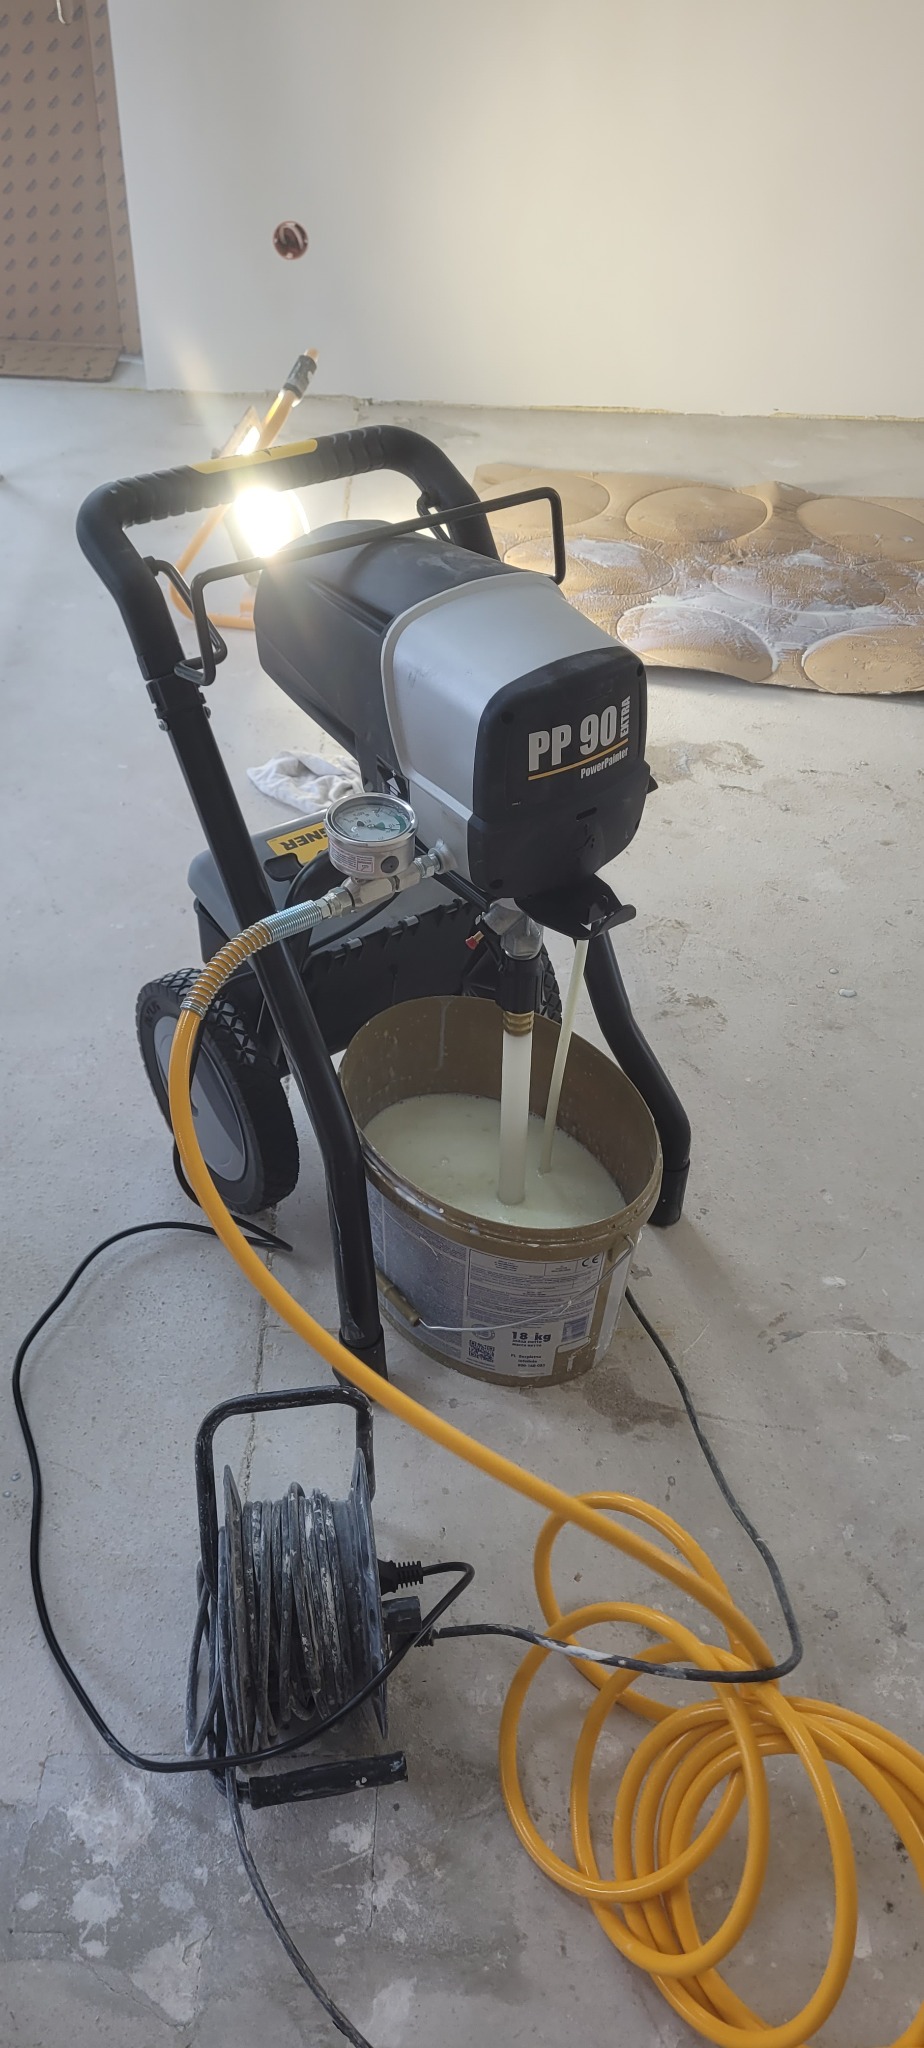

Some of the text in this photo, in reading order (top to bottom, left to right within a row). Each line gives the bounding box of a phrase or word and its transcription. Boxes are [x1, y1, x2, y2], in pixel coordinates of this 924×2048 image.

[620, 695, 631, 738] EXTRA
[528, 705, 618, 772] PP 90
[580, 747, 629, 779] PowerPainter
[512, 1331, 528, 1340] 18
[535, 1332, 551, 1342] kg
